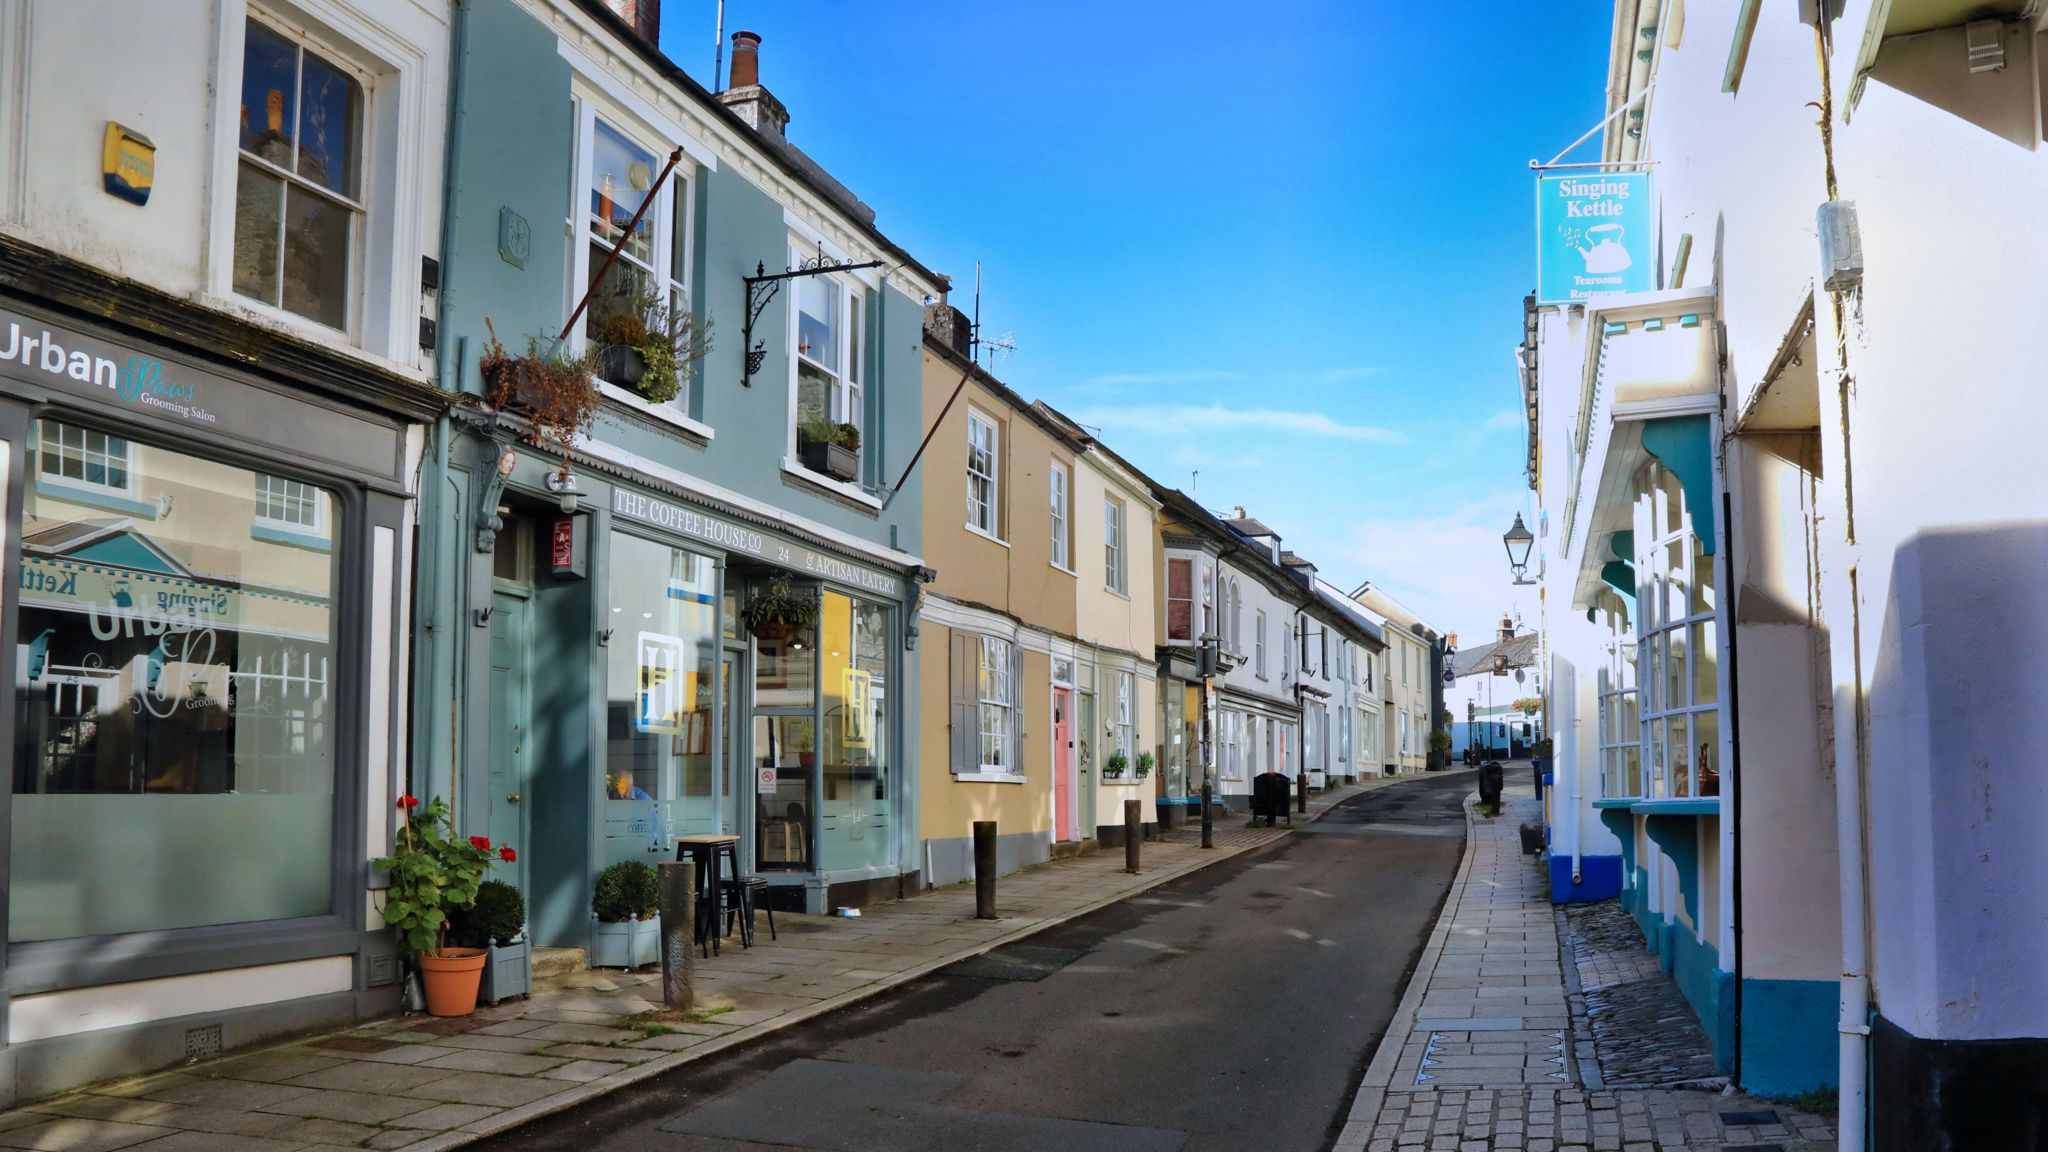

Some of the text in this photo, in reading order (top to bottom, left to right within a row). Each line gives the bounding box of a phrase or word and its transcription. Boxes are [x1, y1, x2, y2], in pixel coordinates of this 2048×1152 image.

[1559, 178, 1630, 199] Singing
[1566, 199, 1624, 218] Kettle
[1573, 275, 1623, 286] Tearooms
[0, 323, 195, 405] Urban Paws
[141, 392, 216, 423] Grooming Salon
[615, 489, 896, 594] THE COFFEE HOUSE CO 24 & ARTISAN EATERY
[185, 694, 235, 710] Groomg
